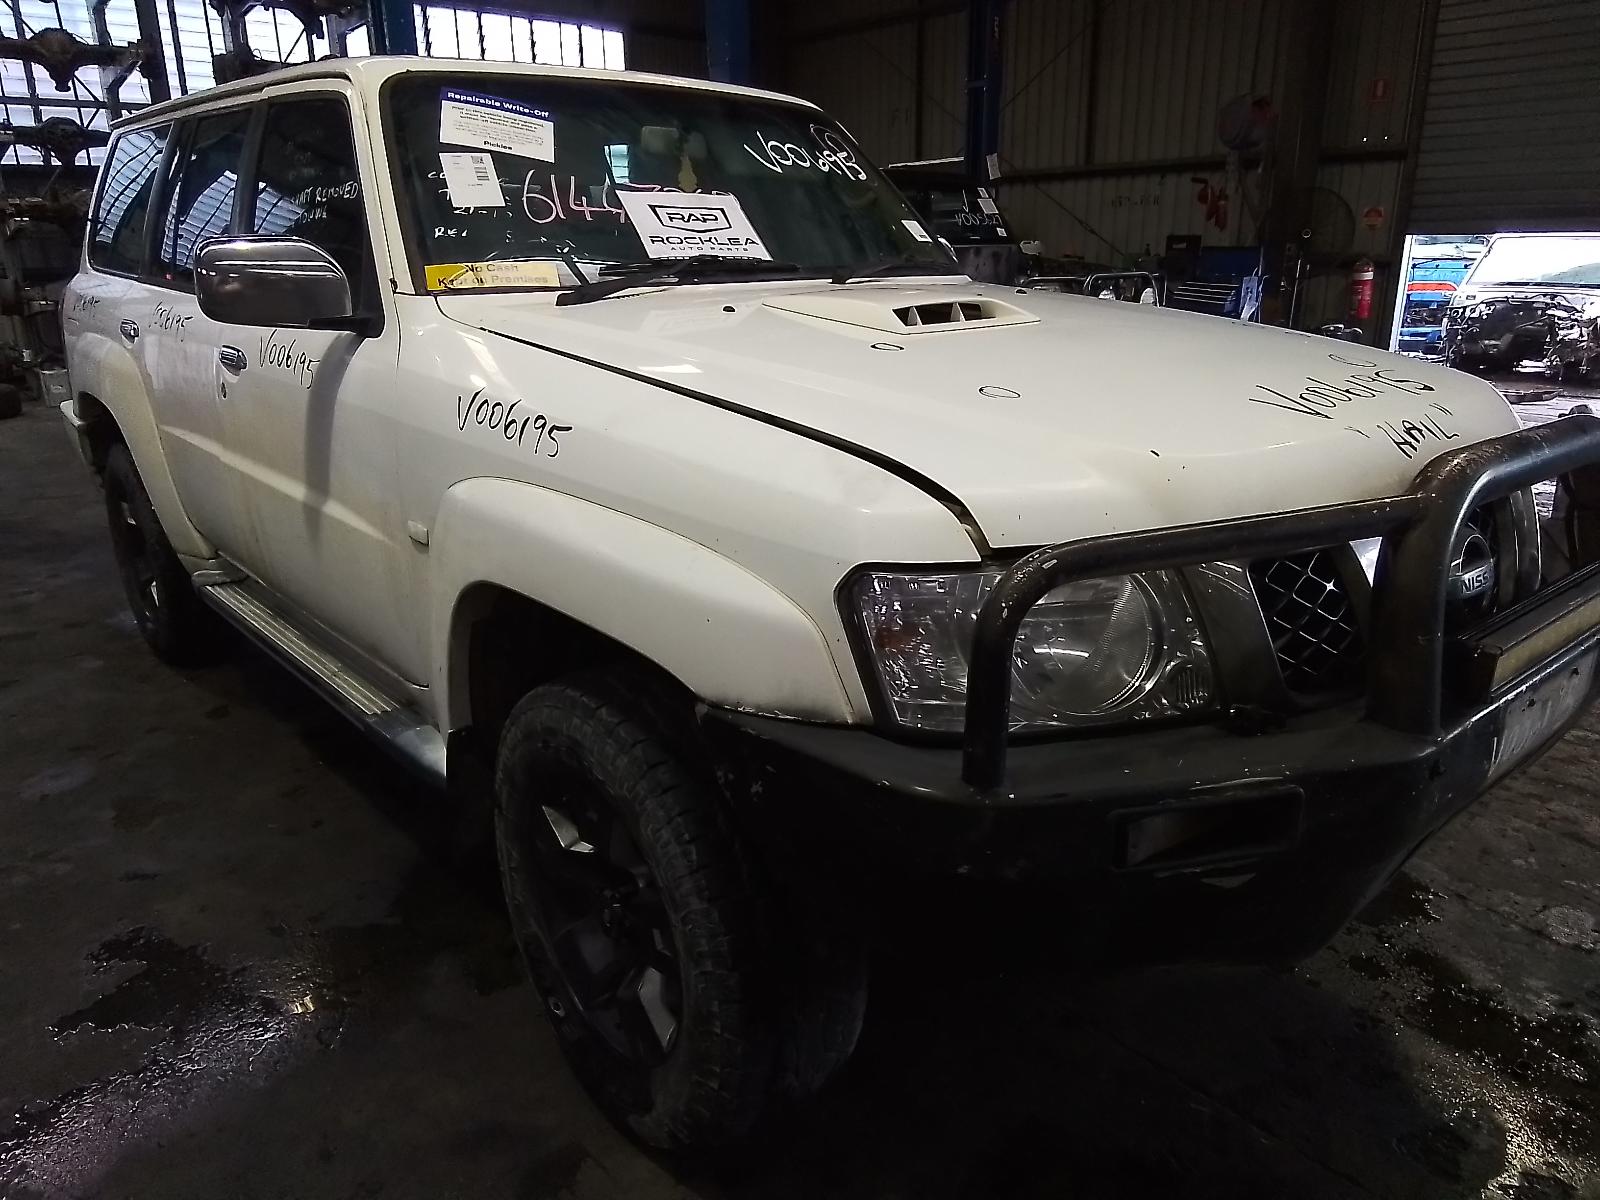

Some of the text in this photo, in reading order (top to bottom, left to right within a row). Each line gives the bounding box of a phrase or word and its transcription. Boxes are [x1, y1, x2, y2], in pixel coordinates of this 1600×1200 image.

[447, 92, 550, 118] Repairable Write-Off
[316, 181, 359, 204] REMOVED
[665, 211, 719, 224] RAP
[648, 235, 760, 247] ROCKLEA
[465, 263, 519, 273] No Cash
[491, 275, 549, 284] Premises
[259, 328, 321, 390] V006195
[1248, 369, 1436, 420] V006195
[457, 386, 573, 458] V006195
[1461, 571, 1489, 594] NISS
